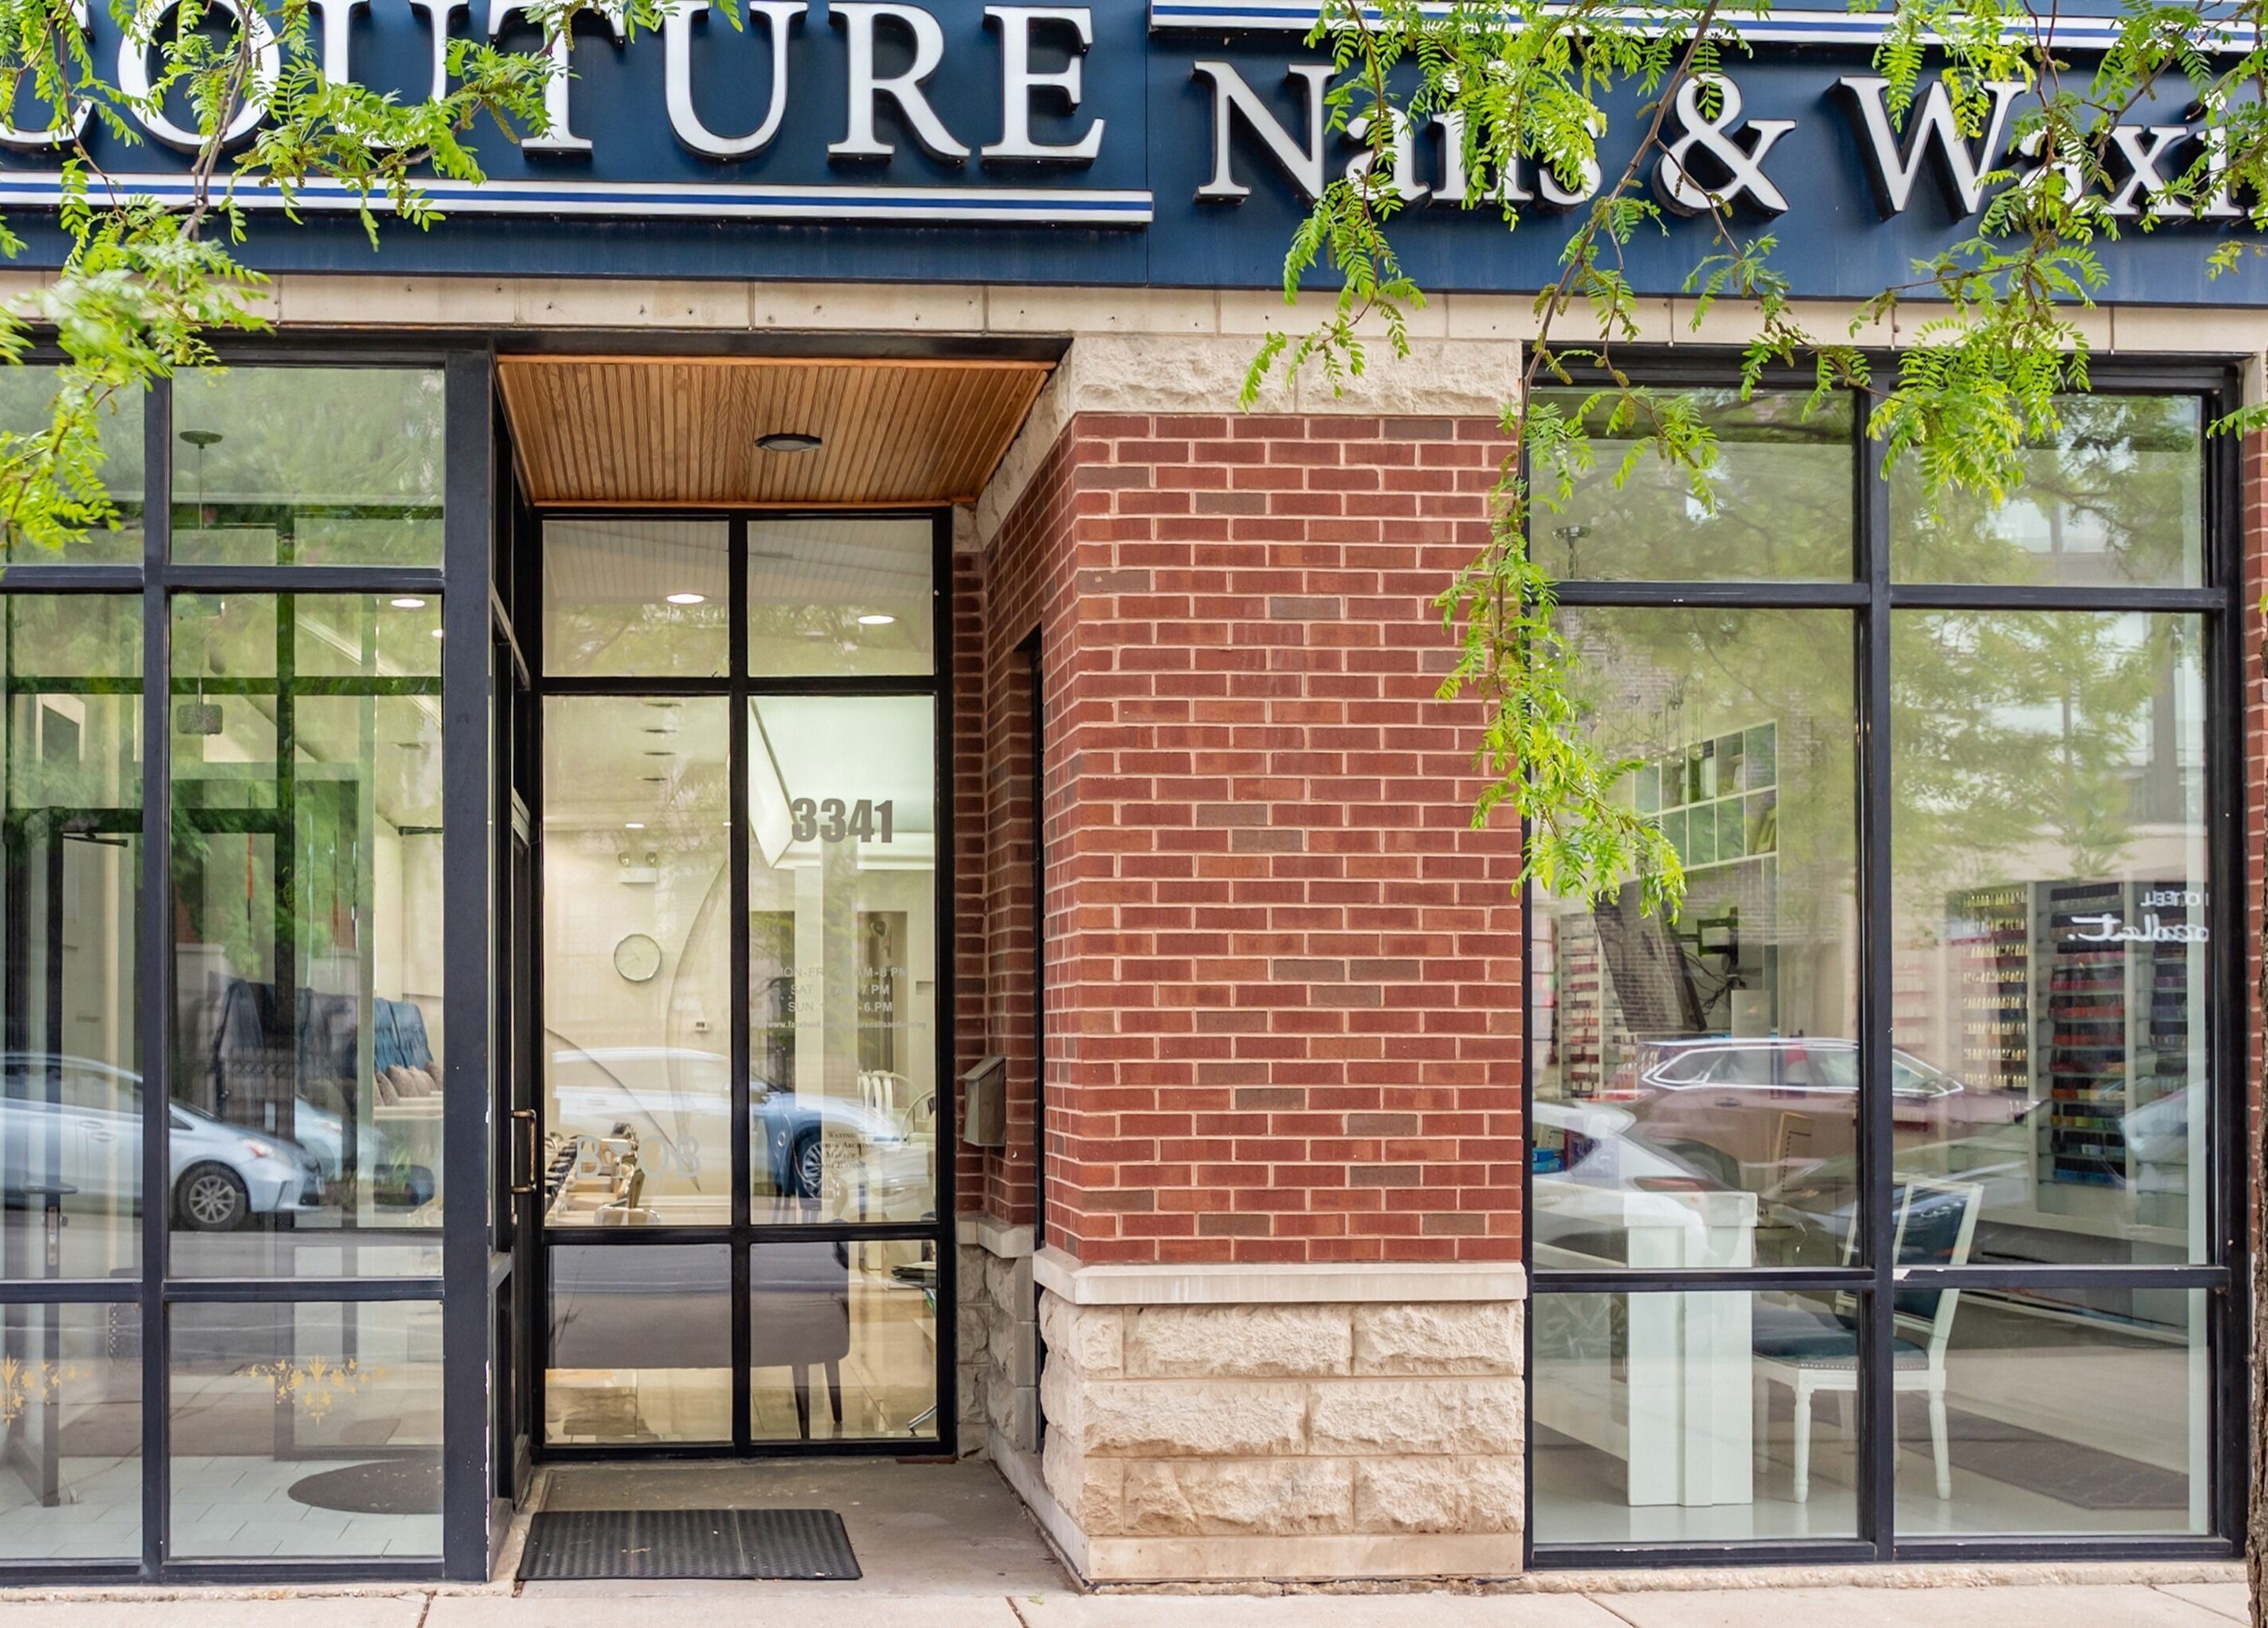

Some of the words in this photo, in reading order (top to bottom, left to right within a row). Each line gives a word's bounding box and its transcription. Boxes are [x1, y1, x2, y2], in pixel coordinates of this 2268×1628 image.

[1659, 73, 1797, 213] &
[1839, 76, 2268, 216] Waxi
[791, 798, 893, 843] 3341
[790, 984, 813, 995] SAT
[871, 984, 890, 995] PM
[787, 1002, 813, 1012] SUN
[874, 1002, 892, 1012] PM
